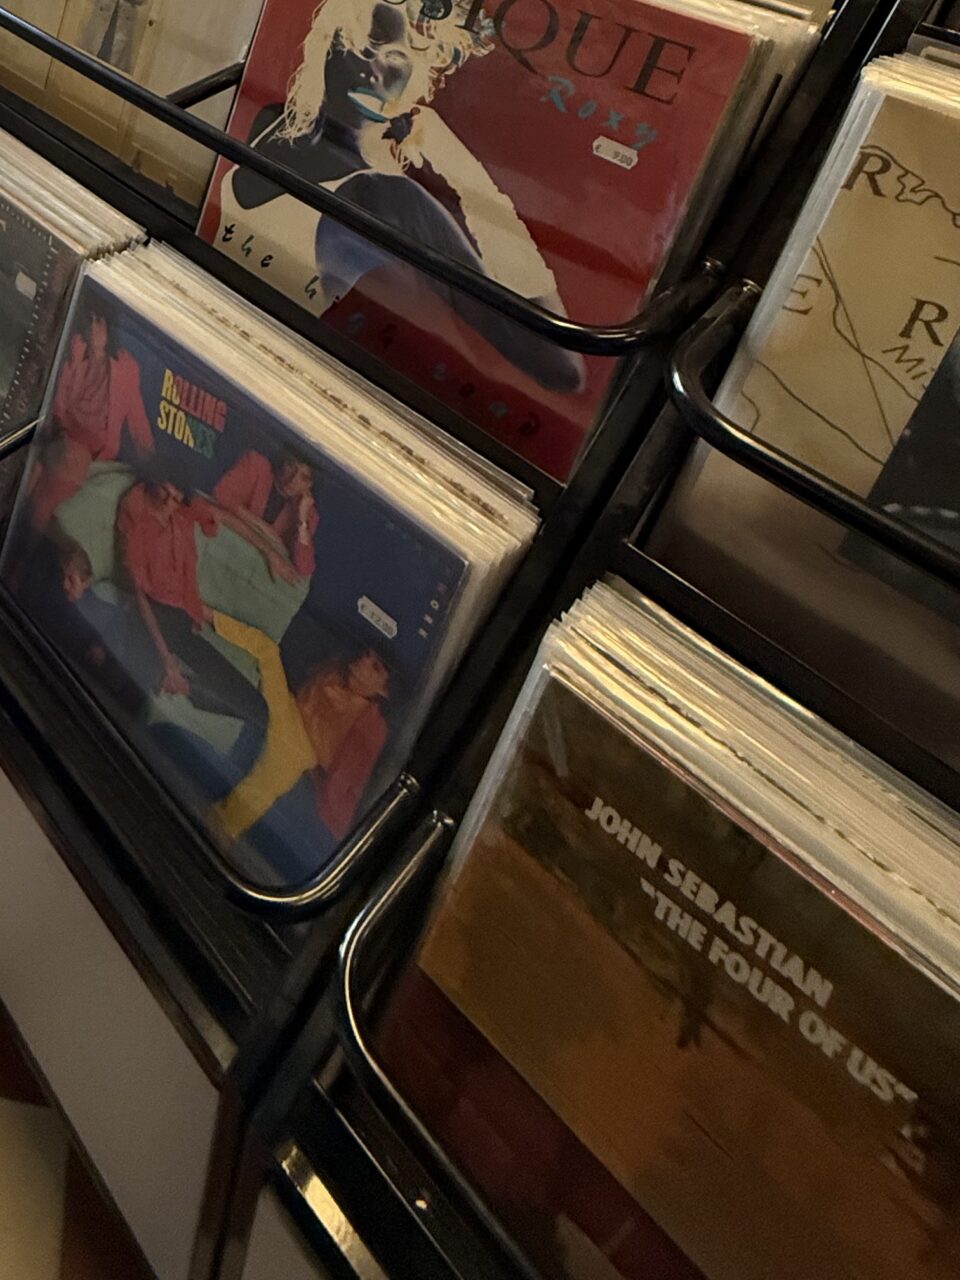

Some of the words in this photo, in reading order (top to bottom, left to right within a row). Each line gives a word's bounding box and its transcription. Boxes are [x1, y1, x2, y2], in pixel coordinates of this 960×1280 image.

[222, 222, 274, 268] the
[157, 399, 217, 459] STONES
[161, 367, 228, 433] ROLLING
[584, 796, 664, 869] JOHN
[663, 857, 834, 1009] SEBASTIAN
[708, 938, 795, 1024] FOUR
[799, 1009, 848, 1059] OF
